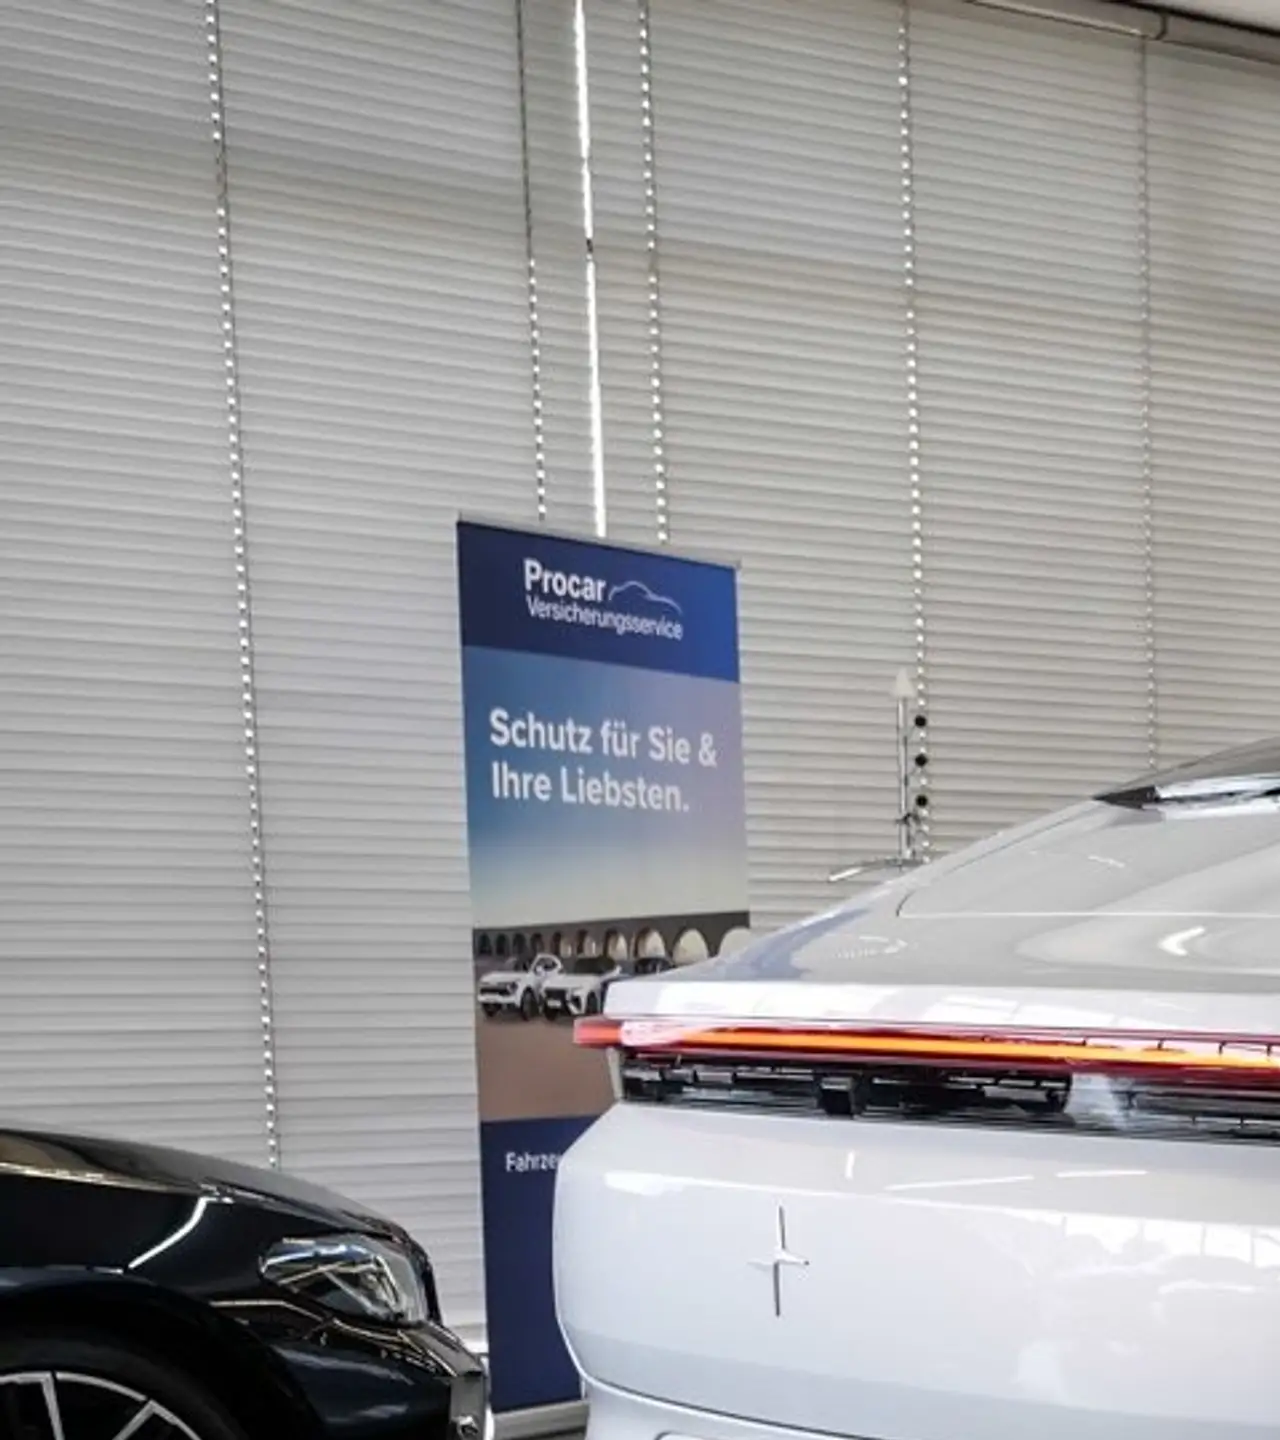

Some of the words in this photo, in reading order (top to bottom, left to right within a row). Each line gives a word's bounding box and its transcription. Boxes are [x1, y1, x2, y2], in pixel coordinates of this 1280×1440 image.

[523, 557, 606, 602] Procar
[525, 594, 683, 641] Versicherungsservice
[490, 707, 593, 754] Schutz
[600, 719, 640, 759] für
[648, 725, 691, 764] Sie
[698, 732, 718, 767] &
[491, 761, 551, 802] Ihre
[560, 766, 689, 812] Liebsten.
[506, 1152, 561, 1172] Fahrze
